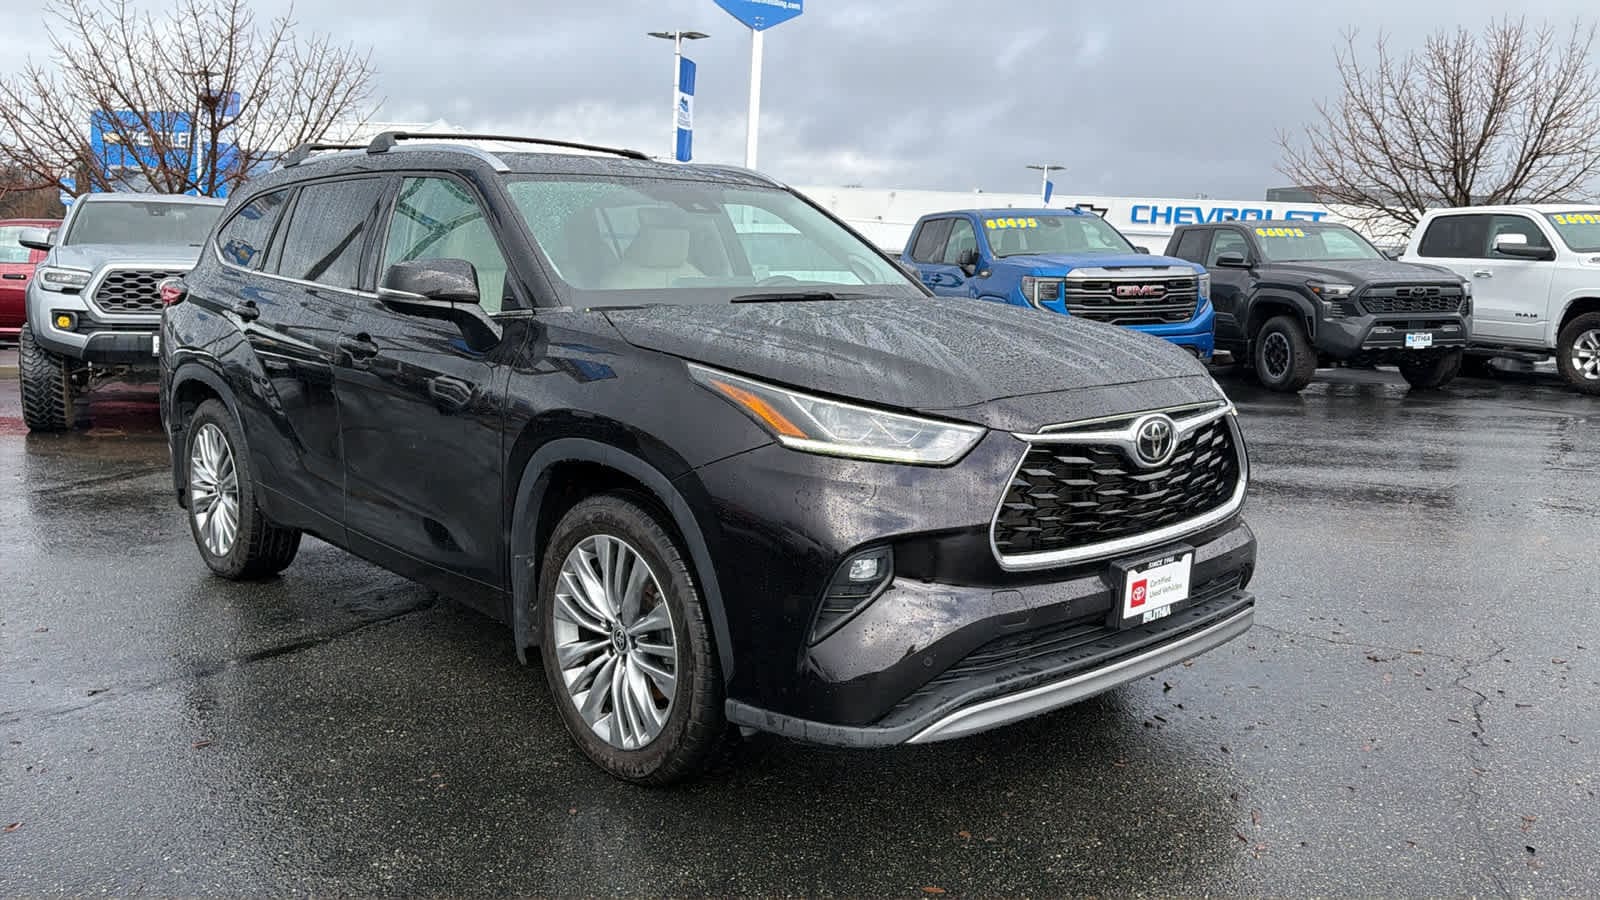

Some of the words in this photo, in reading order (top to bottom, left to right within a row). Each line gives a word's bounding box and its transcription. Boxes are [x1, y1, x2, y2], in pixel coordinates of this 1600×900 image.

[1131, 205, 1328, 224] CHEVROLET
[1116, 284, 1165, 296] GMC
[1150, 575, 1172, 588] Certified
[1149, 588, 1162, 598] Used
[1162, 583, 1183, 594] Vehicles
